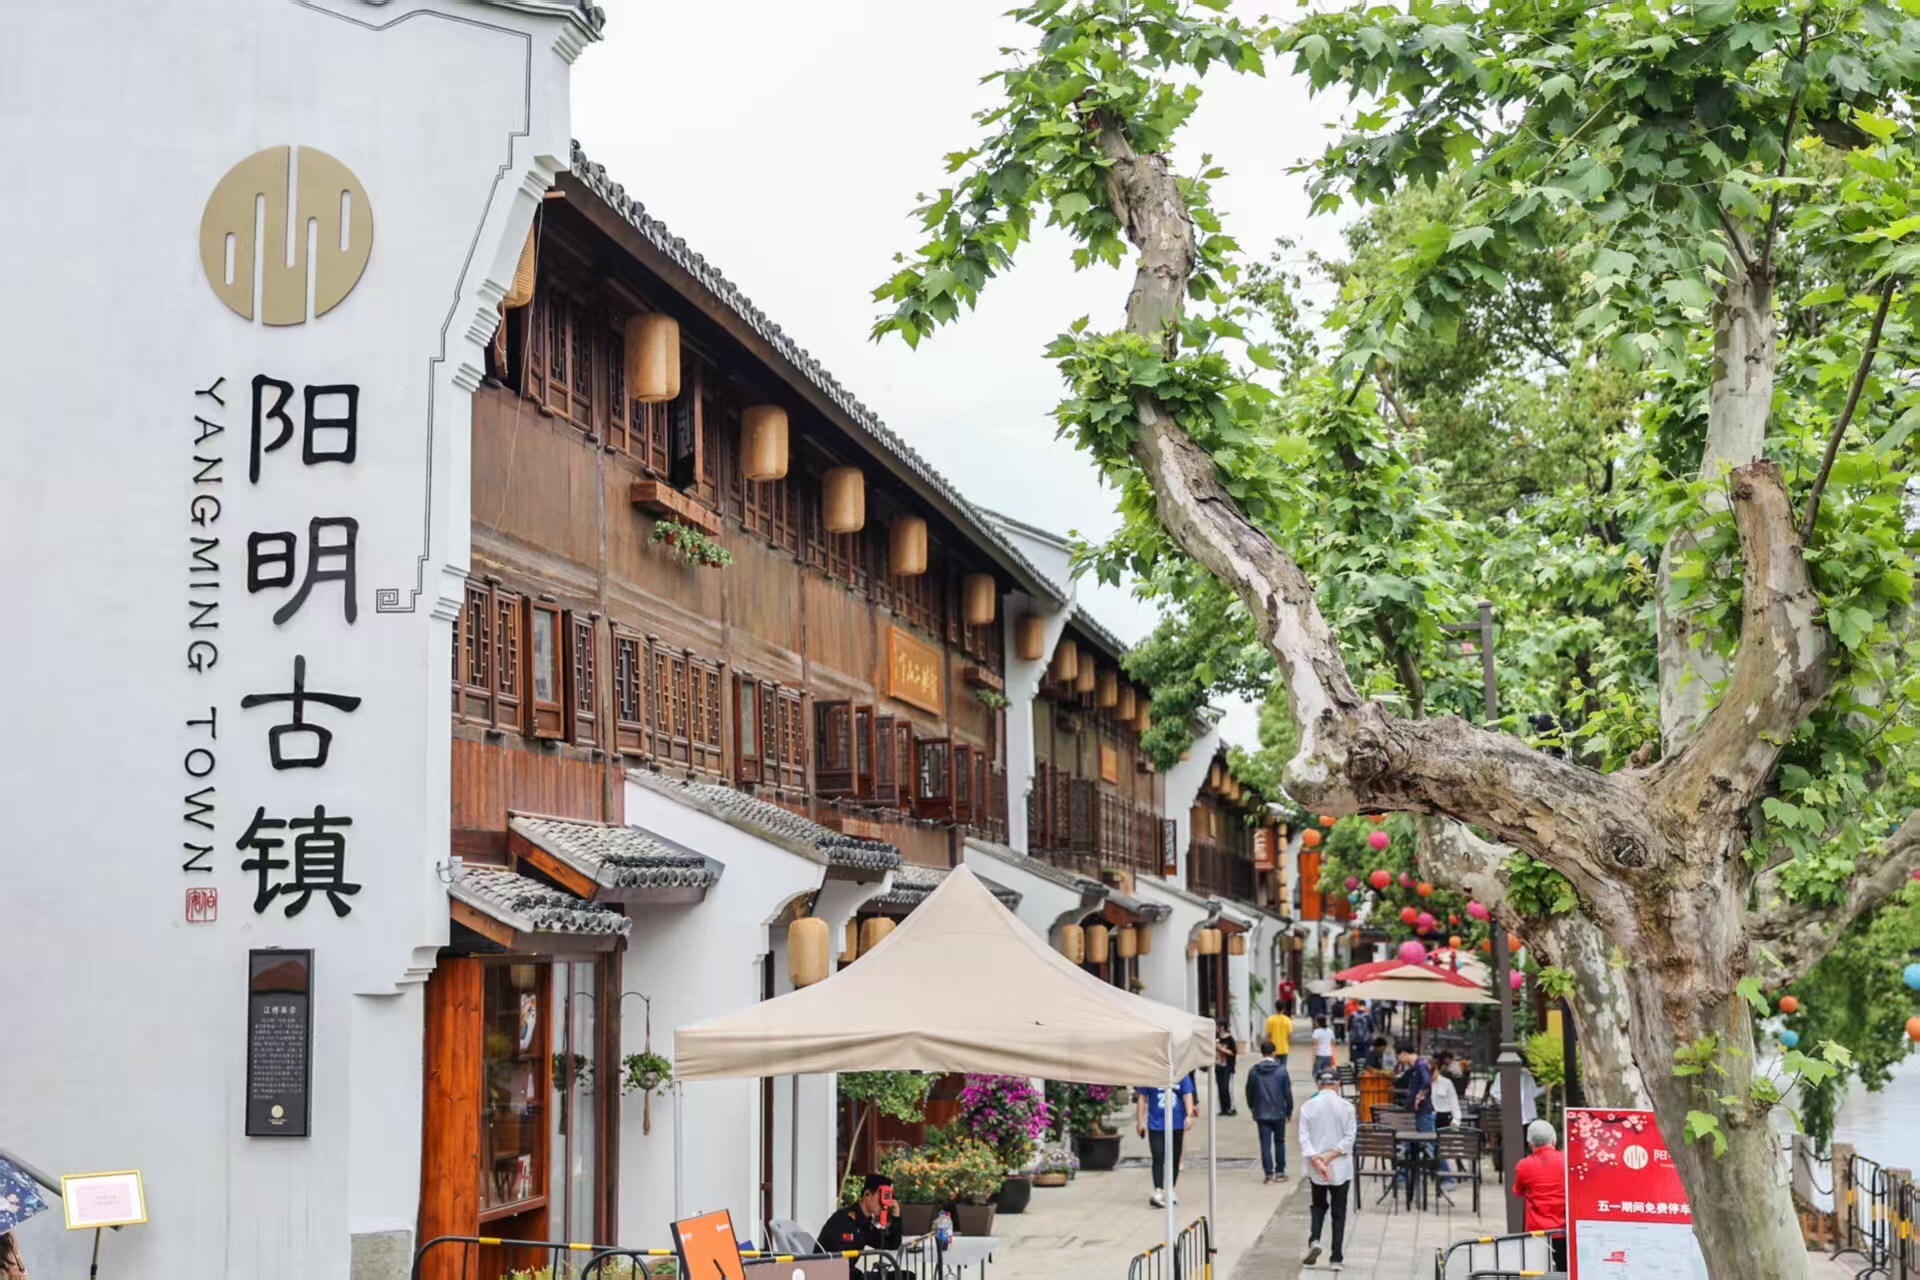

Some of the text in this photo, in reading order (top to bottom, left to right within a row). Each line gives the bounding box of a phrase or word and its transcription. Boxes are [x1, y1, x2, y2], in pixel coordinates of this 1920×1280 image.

[183, 377, 226, 873] YANGMING TOWN
[236, 374, 361, 918] 阳明古镇
[1597, 1200, 1691, 1214] 五一期间免费停车
[1653, 1149, 1671, 1162] 阳
